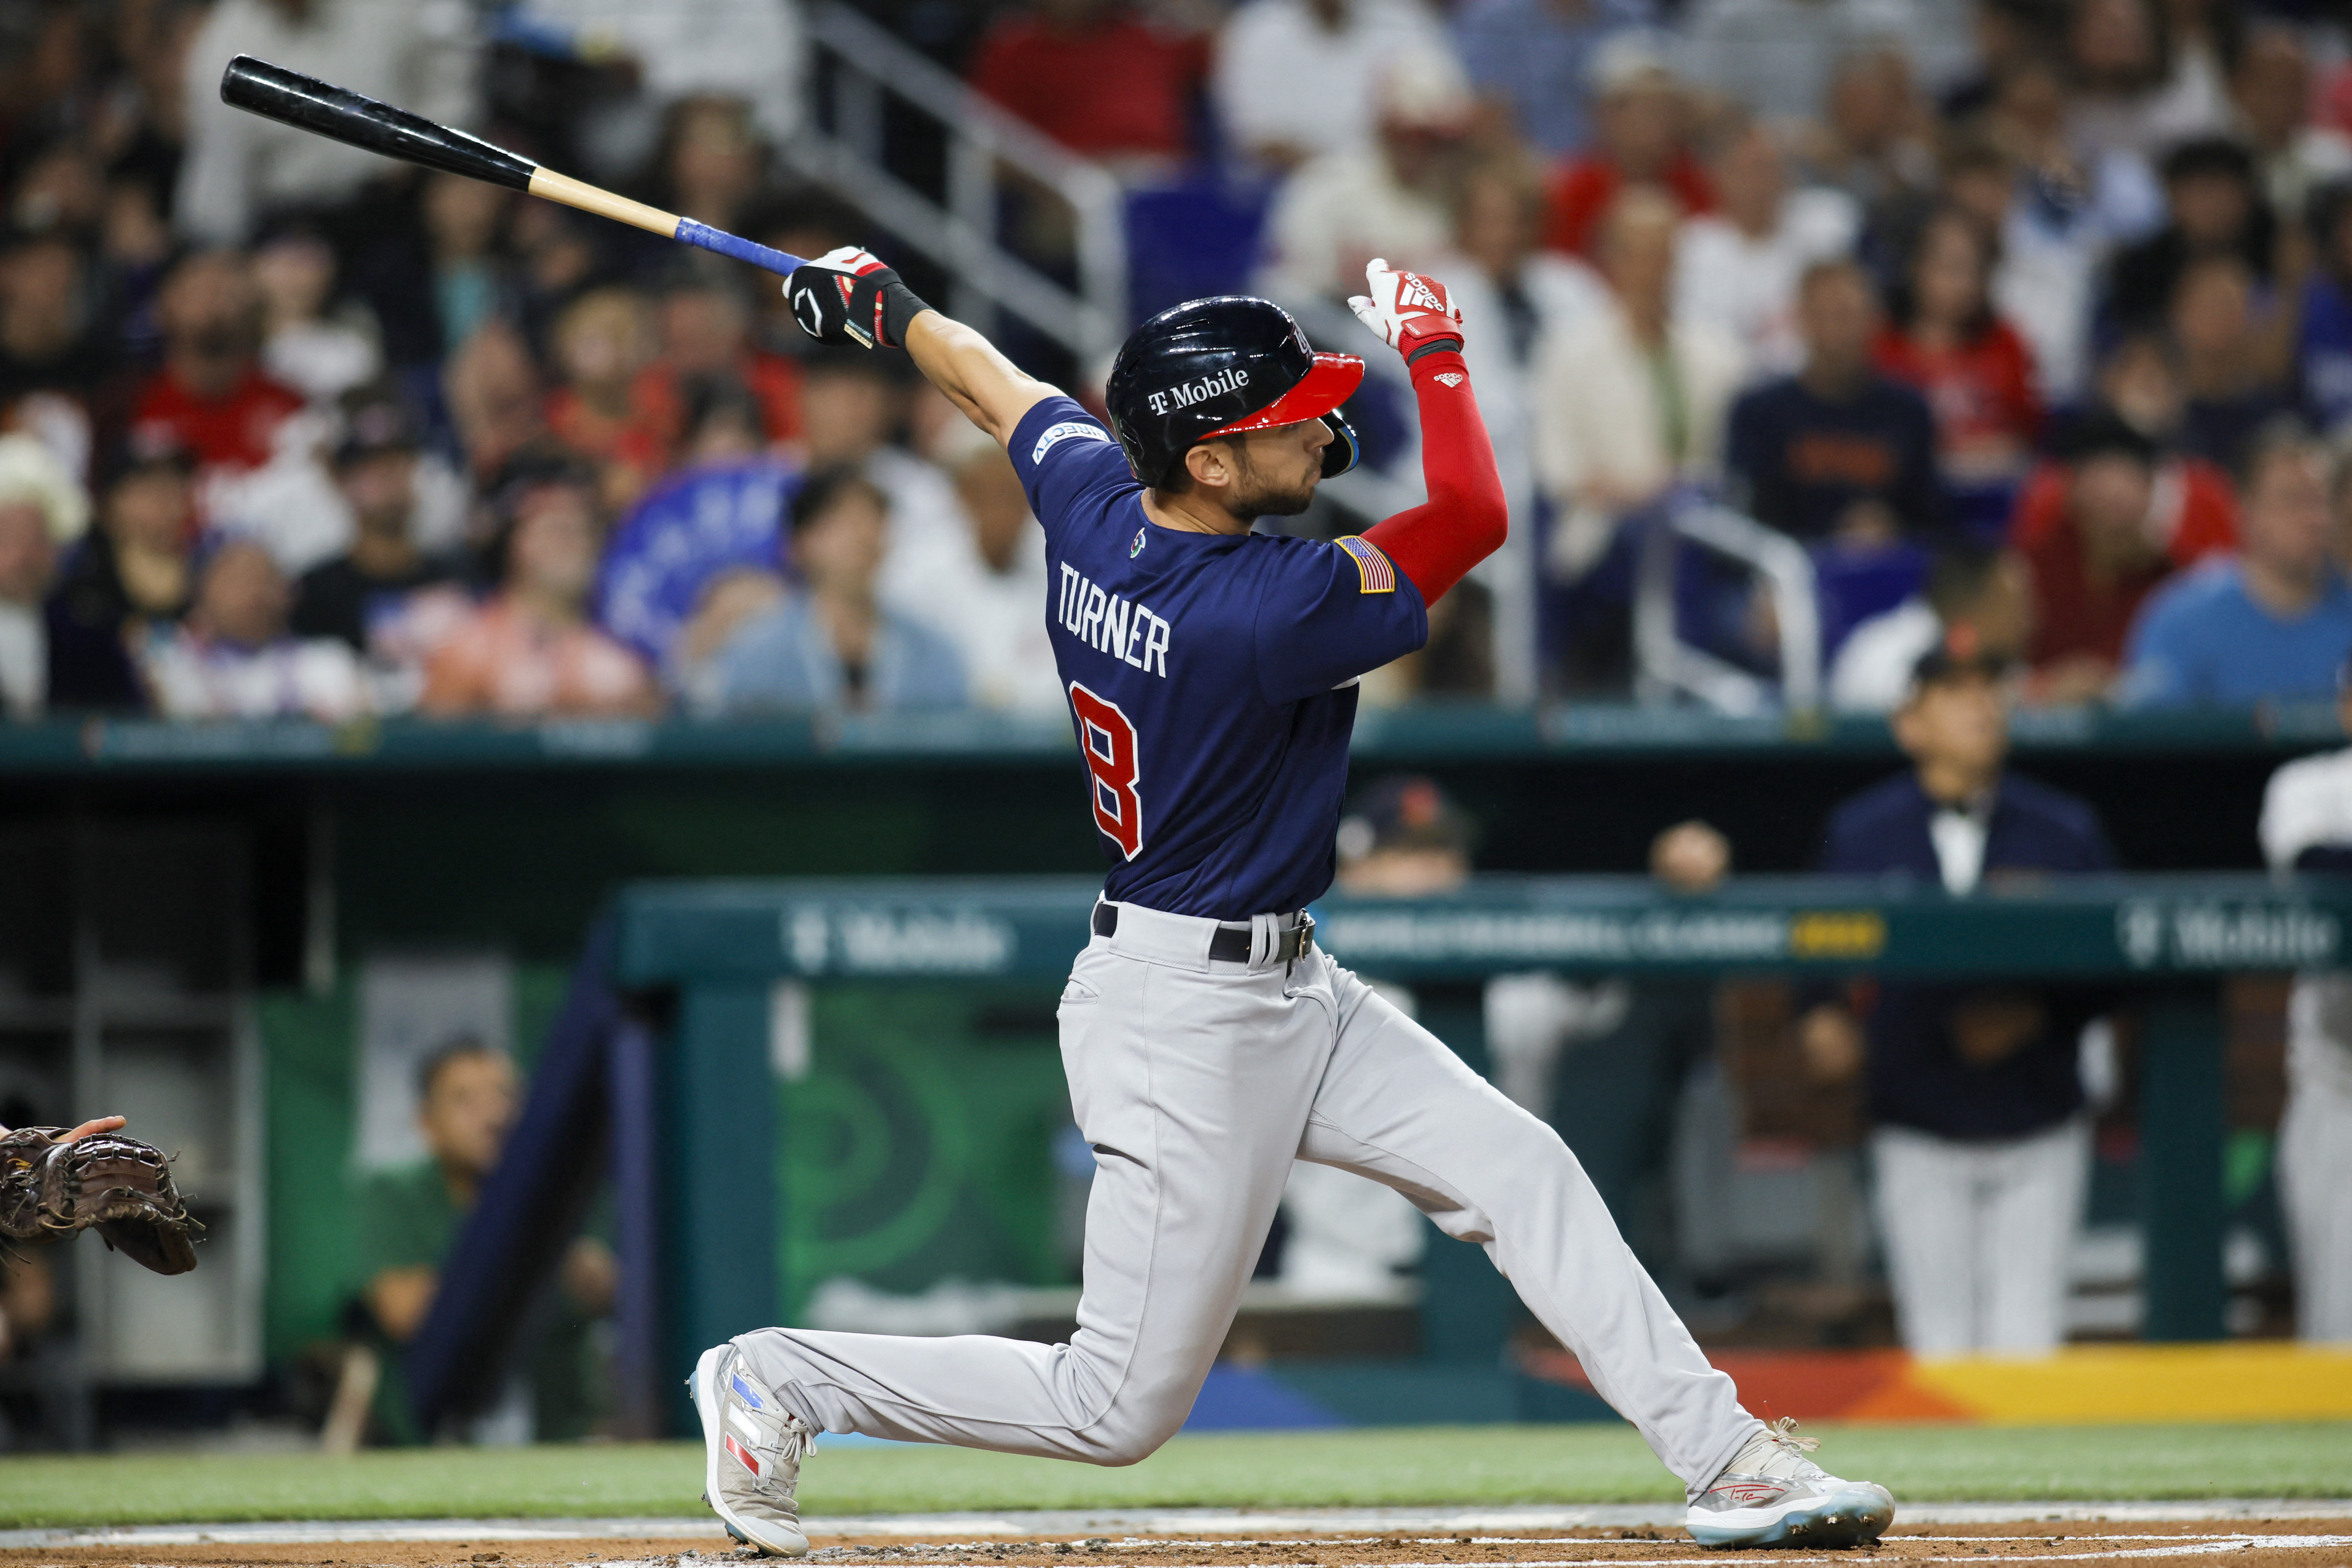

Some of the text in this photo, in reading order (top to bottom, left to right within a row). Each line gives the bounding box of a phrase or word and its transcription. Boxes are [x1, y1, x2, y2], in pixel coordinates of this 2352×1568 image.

[1405, 273, 1445, 311] adidas
[1405, 323, 1421, 336] ADIZERO
[1148, 368, 1249, 416] T Mobile
[1433, 373, 1463, 381] adidas
[1036, 425, 1108, 460] DIRECTV
[1059, 561, 1170, 678] TURNER
[1069, 680, 1143, 862] 8
